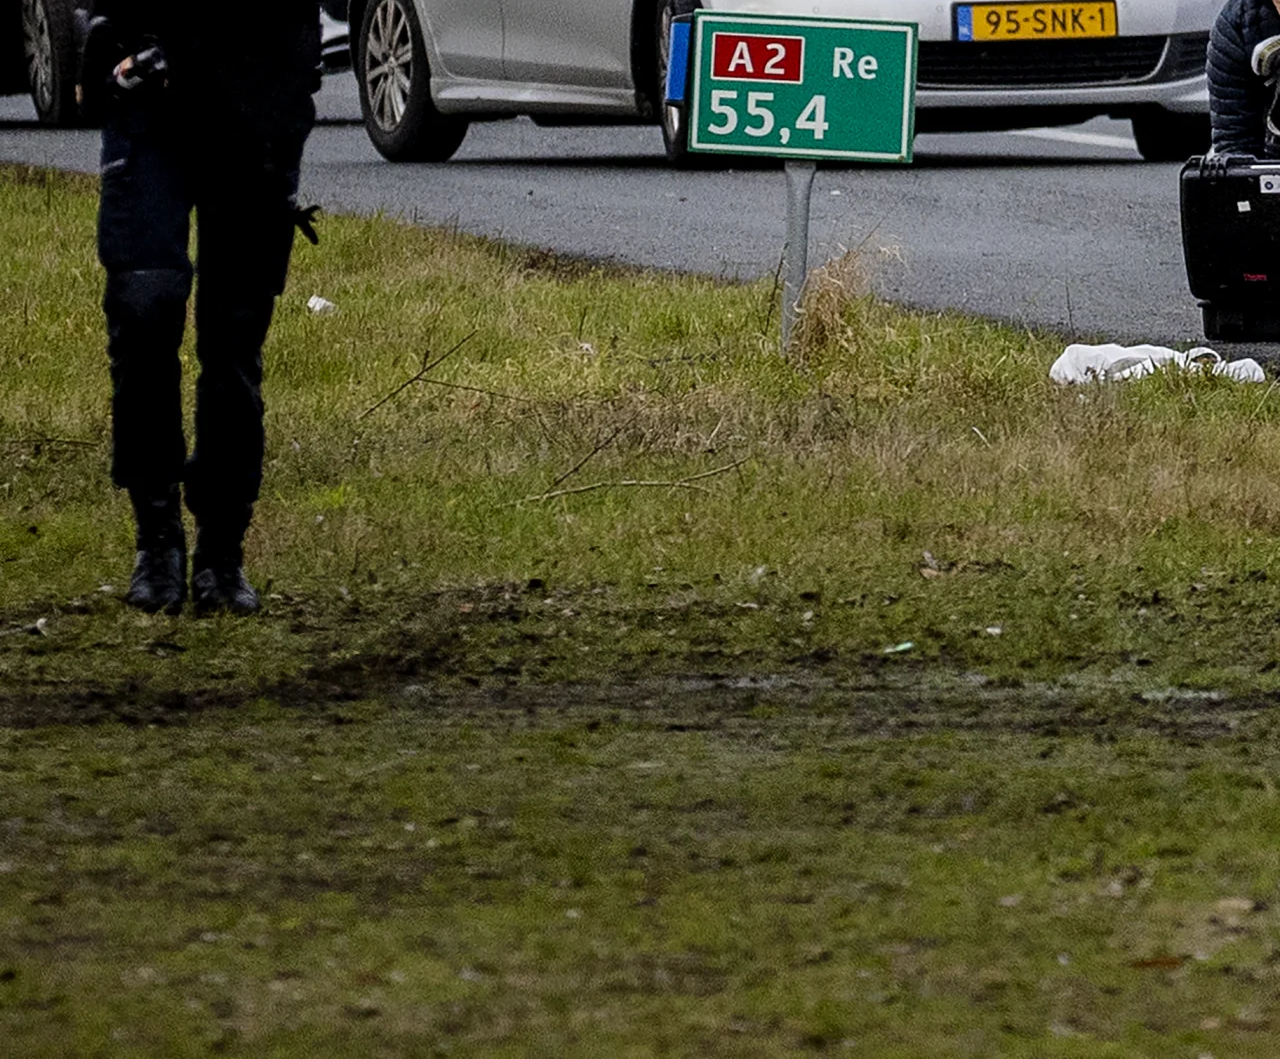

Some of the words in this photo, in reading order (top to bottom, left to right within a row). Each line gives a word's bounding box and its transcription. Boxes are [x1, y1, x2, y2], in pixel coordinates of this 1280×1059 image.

[986, 8, 1105, 35] 95-SNK-1
[832, 47, 878, 80] Re
[707, 89, 829, 144] 55,4
